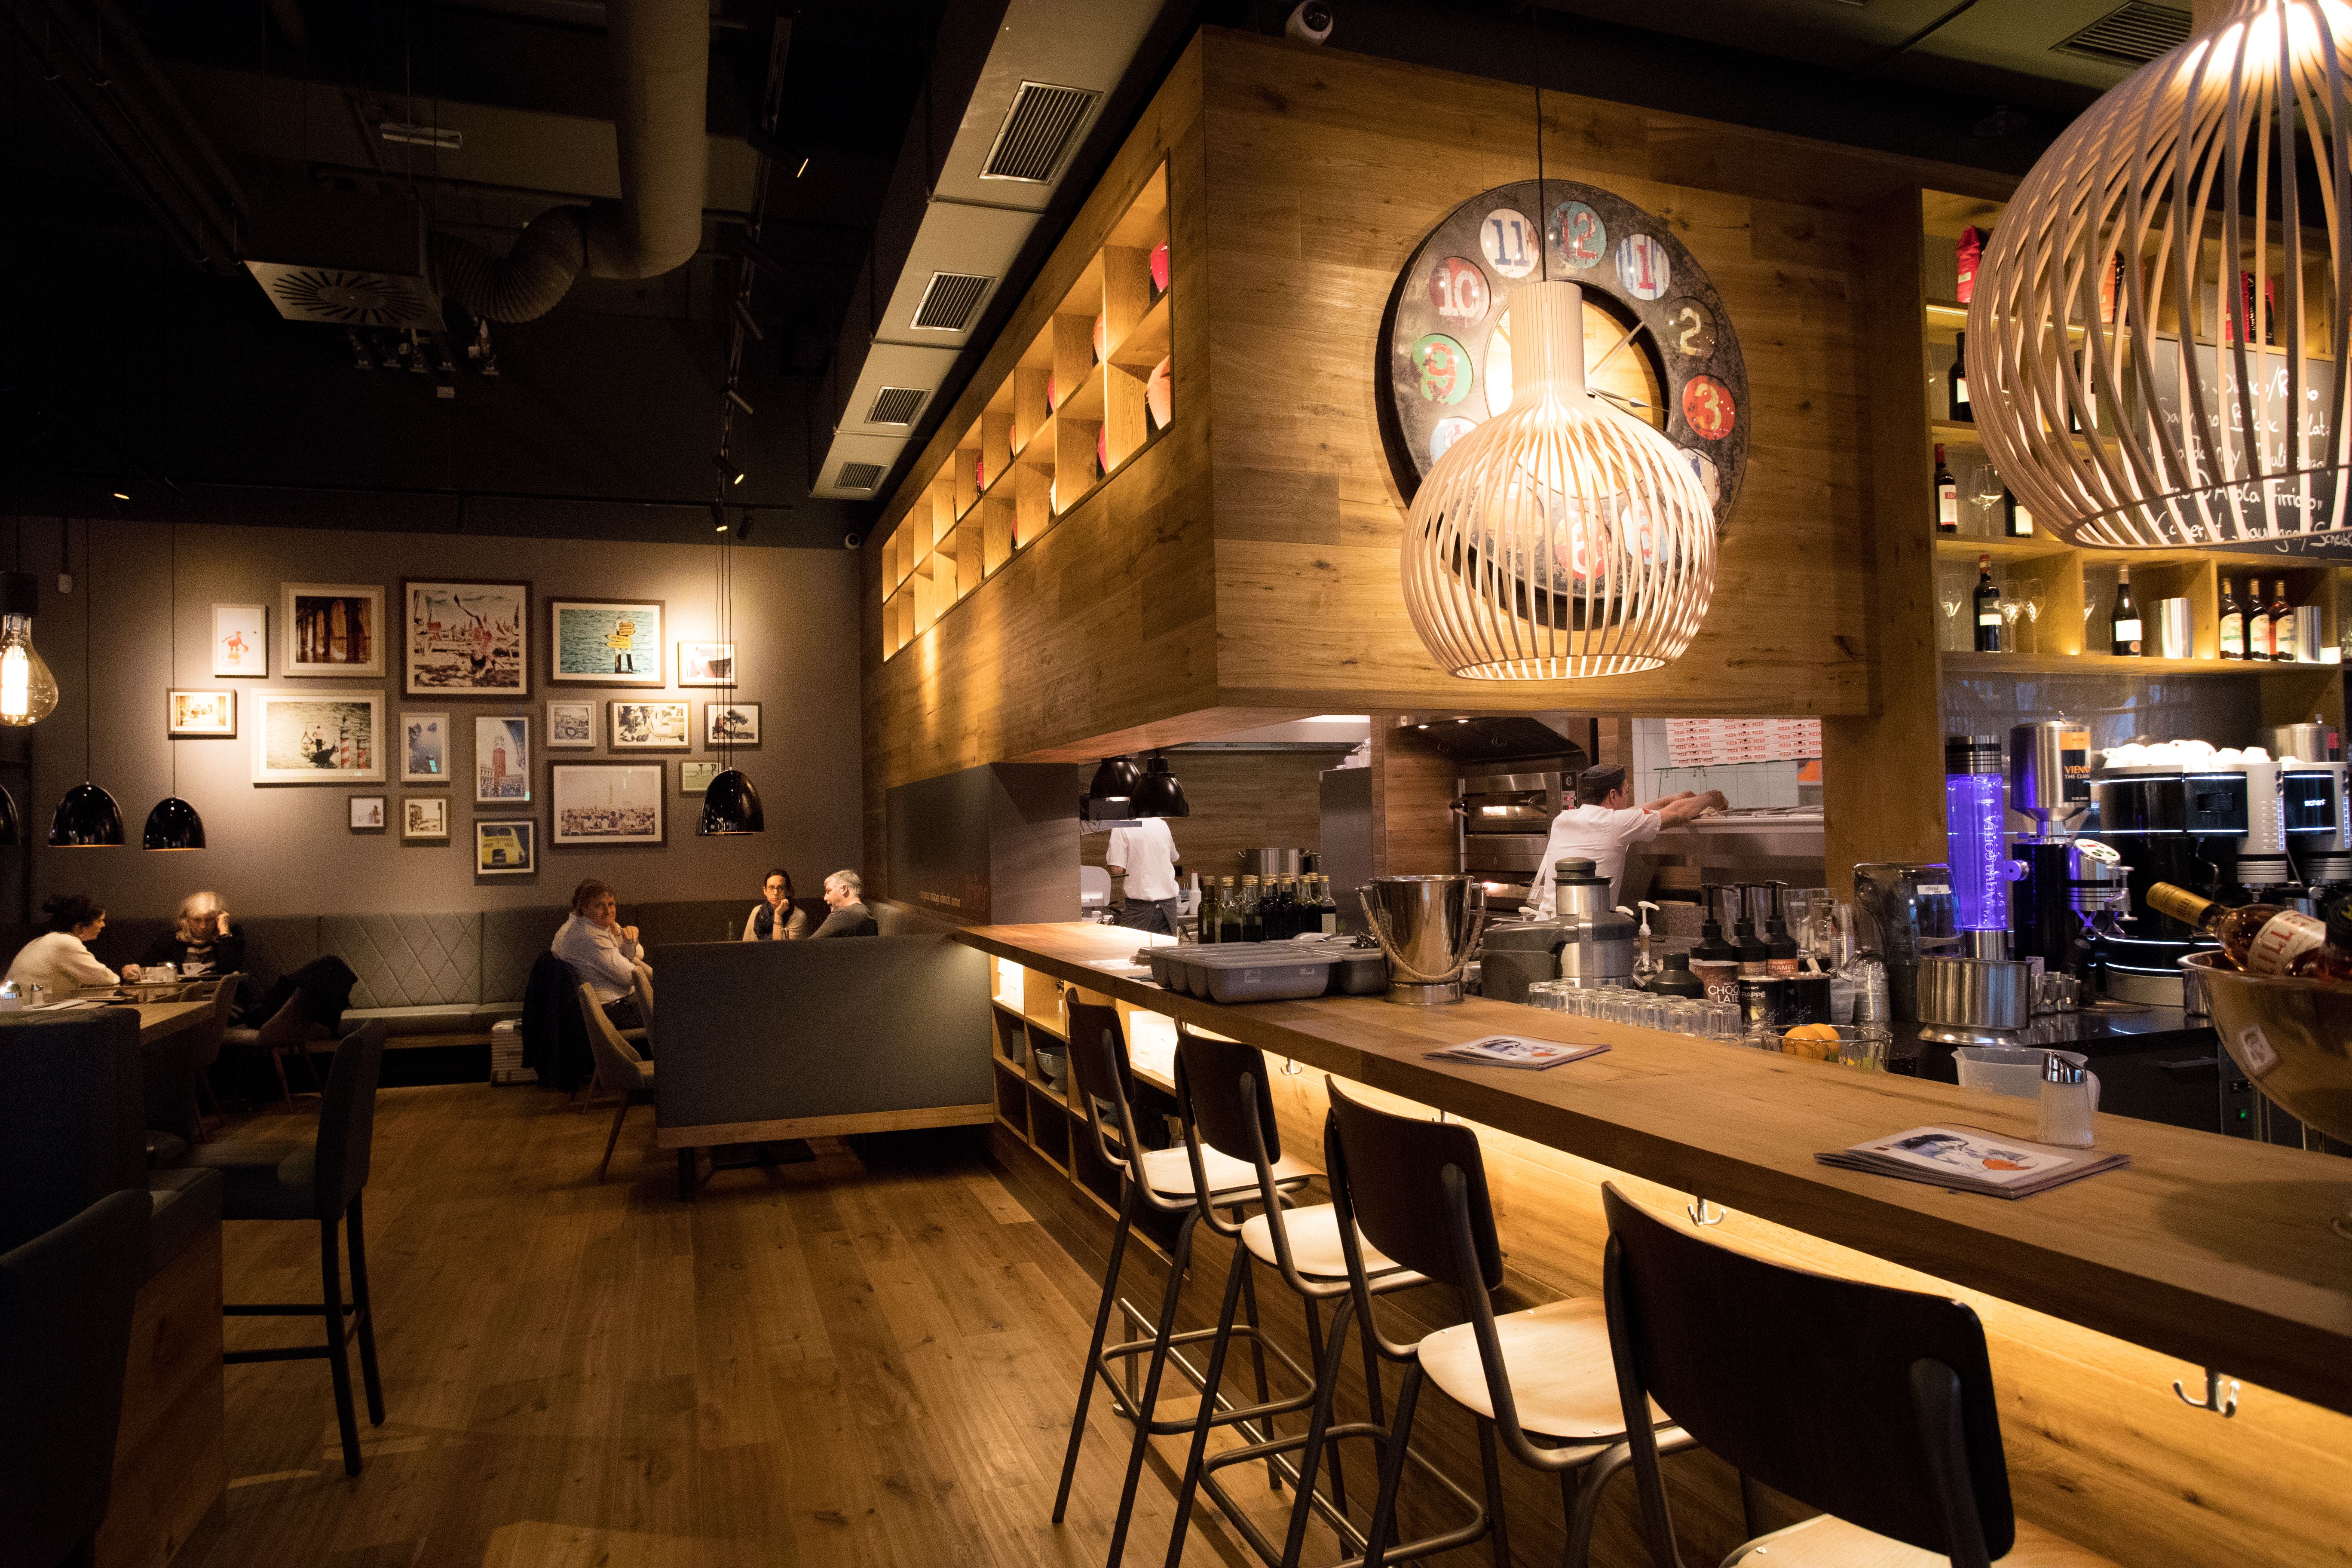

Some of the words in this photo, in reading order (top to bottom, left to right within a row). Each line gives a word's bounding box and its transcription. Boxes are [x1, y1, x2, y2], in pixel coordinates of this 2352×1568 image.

[1489, 218, 1530, 267] 11
[1556, 209, 1599, 260] 12
[1637, 243, 1655, 290] 1
[1439, 266, 1479, 318] 10
[1678, 307, 1702, 356] 2
[1425, 342, 1458, 399] 9
[1692, 383, 1721, 430] 3
